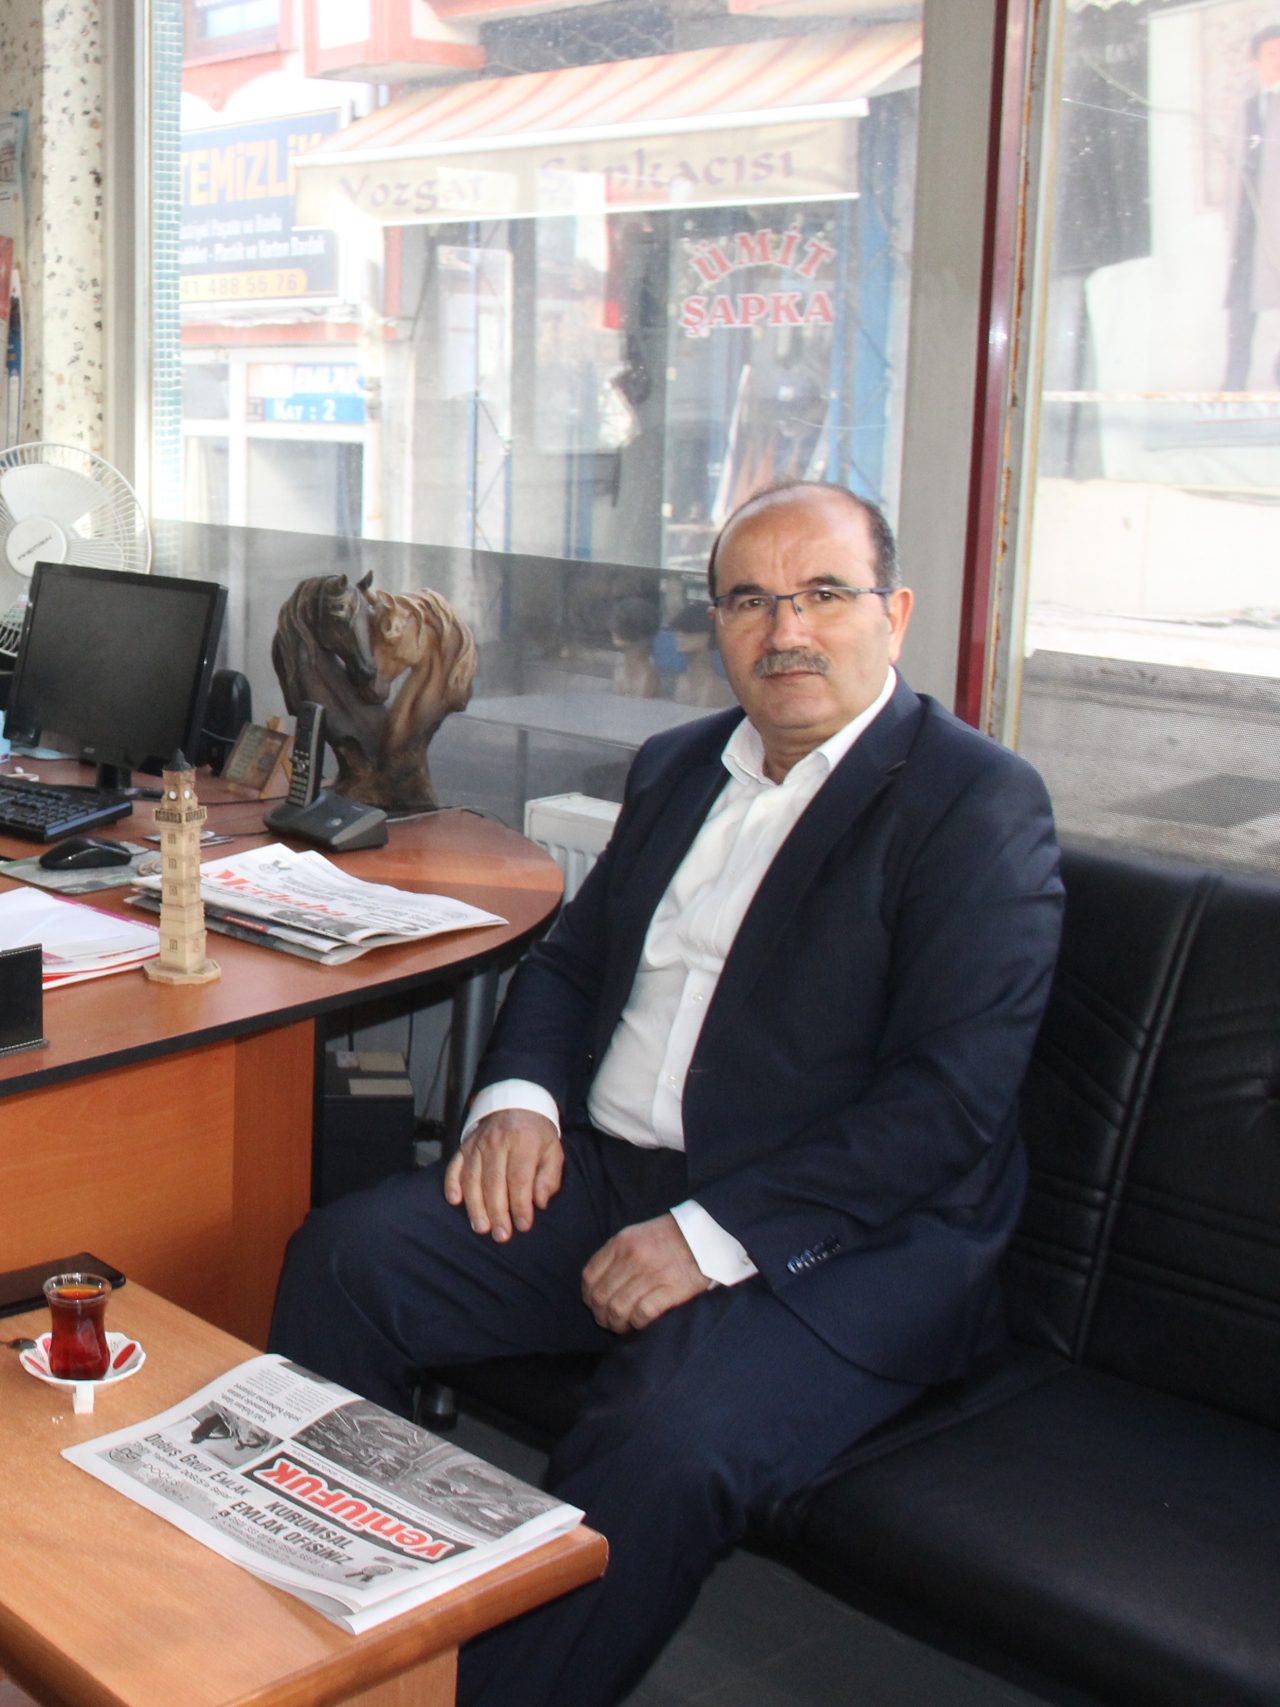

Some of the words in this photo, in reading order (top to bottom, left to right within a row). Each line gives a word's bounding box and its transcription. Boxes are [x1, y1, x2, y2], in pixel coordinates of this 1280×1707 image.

[690, 222, 837, 285] ÜMİT
[246, 275, 268, 294] 55
[276, 272, 299, 292] 76
[679, 290, 834, 338] ŞAPKA
[321, 398, 336, 421] 2
[230, 1500, 289, 1535] EMLAK
[263, 1500, 355, 1550] KURUMSAL
